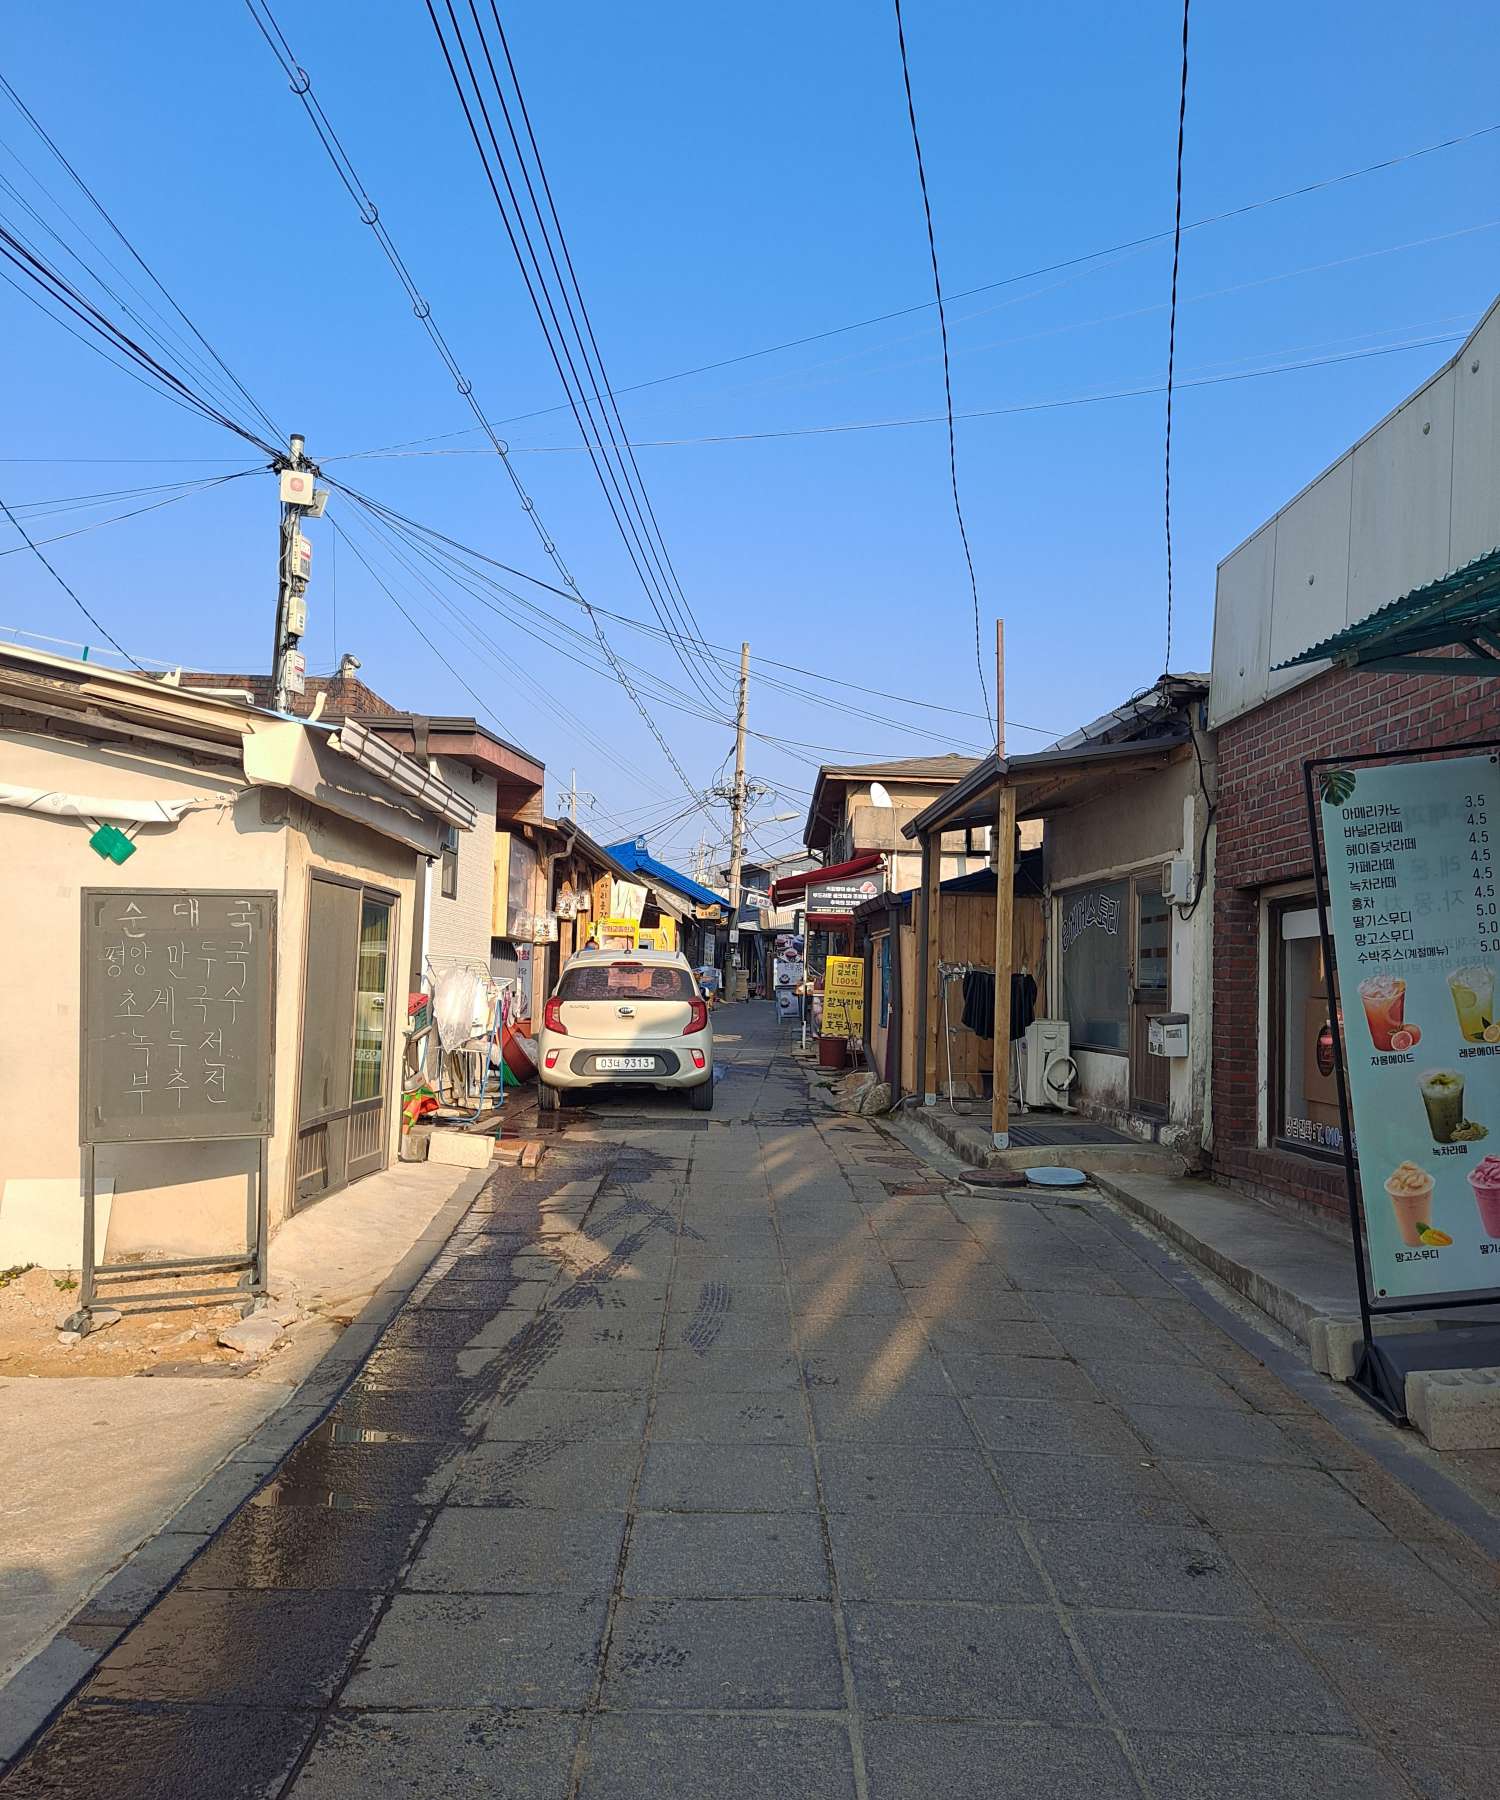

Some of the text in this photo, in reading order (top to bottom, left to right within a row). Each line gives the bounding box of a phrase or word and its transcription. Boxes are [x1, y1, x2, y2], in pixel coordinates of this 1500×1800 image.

[1342, 804, 1401, 821] 아메리카노
[1465, 794, 1485, 808] 3.5
[1344, 821, 1403, 839] 바닐라라떼
[1467, 812, 1487, 826] 4.5
[1345, 830, 1489, 857] 헤이즐넛라떼 4.5
[1348, 848, 1491, 875] 카페라떼 4.5
[1350, 866, 1493, 892] 녹차라떼 4.5
[1352, 897, 1375, 911] 홍차
[1474, 884, 1495, 898] 4.5
[1353, 902, 1497, 929] 딸기스무디 5.0
[1355, 928, 1414, 947] 망고스무디
[1478, 920, 1498, 934] 5.0
[1480, 938, 1500, 953] 5.0
[99, 941, 152, 978] 평양
[624, 1058, 649, 1069] 9313
[1371, 1053, 1416, 1067] 자몽에이드
[1432, 1144, 1468, 1157] 녹차라떼
[1395, 1249, 1440, 1264] 망고스무디
[1479, 1243, 1500, 1255] 딸기
